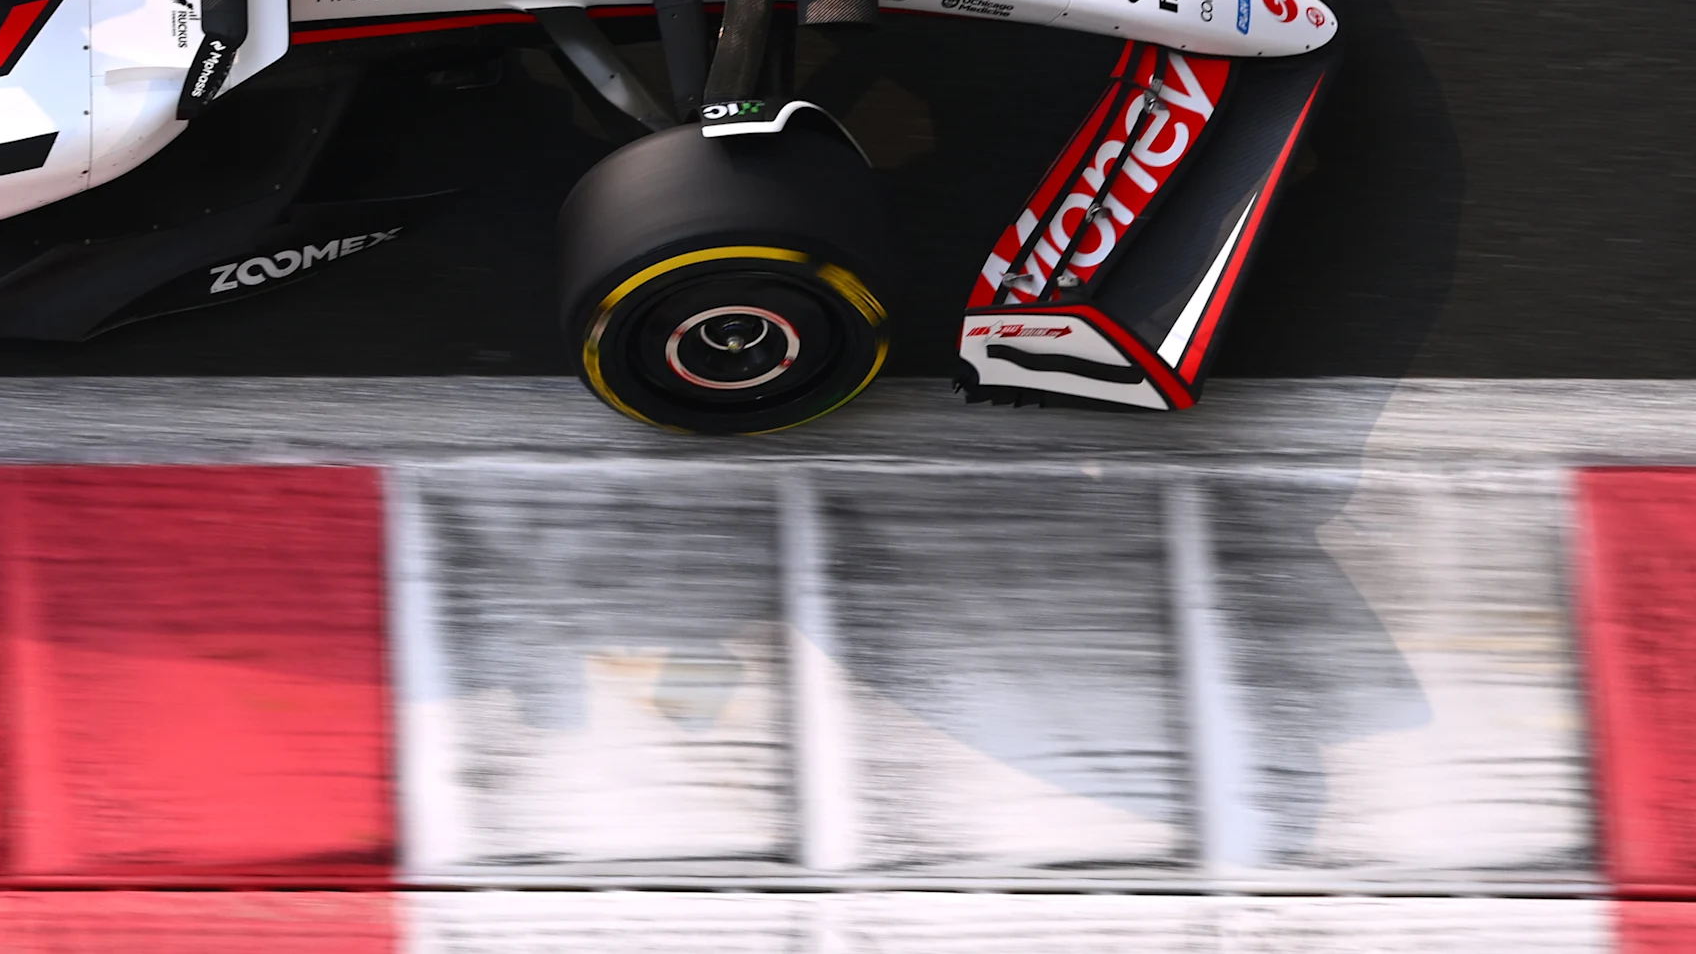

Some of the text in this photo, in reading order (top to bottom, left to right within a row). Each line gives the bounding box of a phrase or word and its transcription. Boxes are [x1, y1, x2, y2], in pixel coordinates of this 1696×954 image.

[178, 10, 188, 48] RUCKUS
[958, 3, 1012, 17] Medicine
[191, 52, 222, 97] Mphasis
[980, 51, 1215, 304] Money
[210, 226, 404, 294] ZOOMEX
